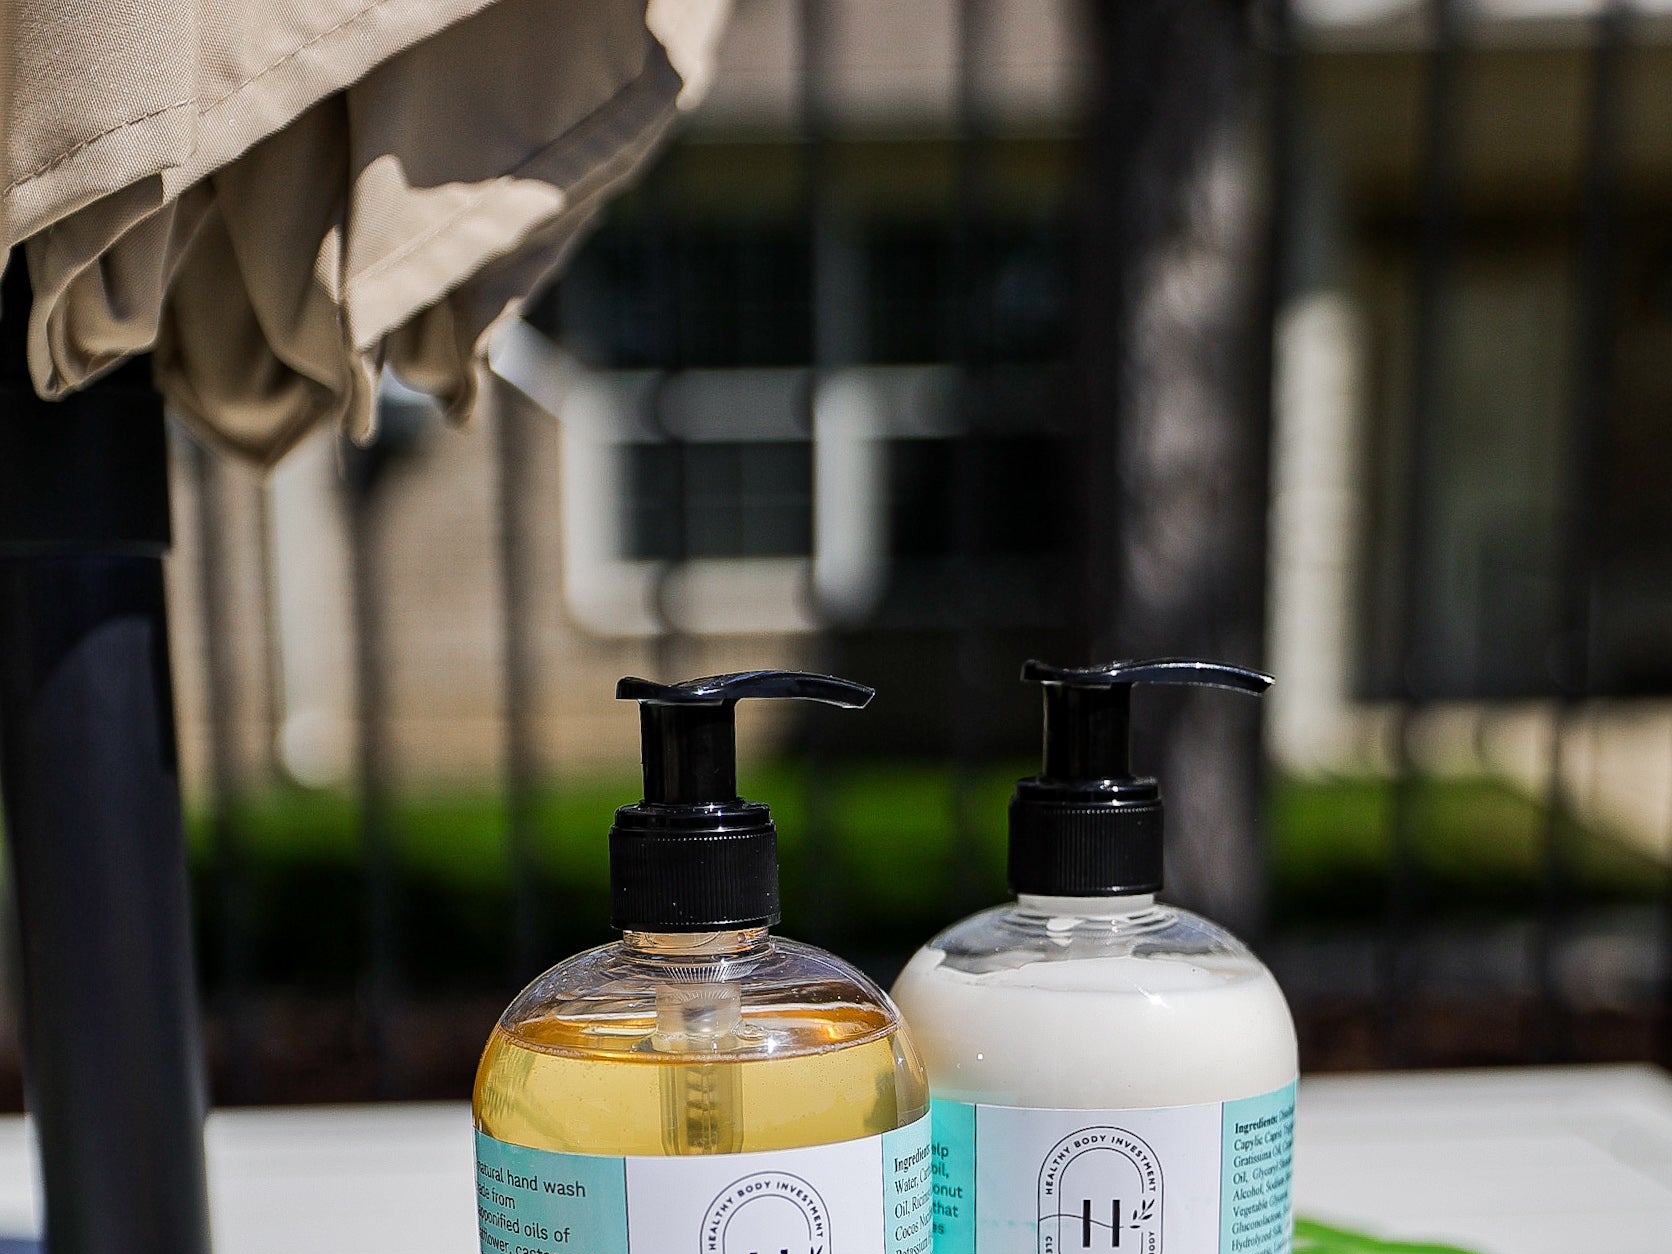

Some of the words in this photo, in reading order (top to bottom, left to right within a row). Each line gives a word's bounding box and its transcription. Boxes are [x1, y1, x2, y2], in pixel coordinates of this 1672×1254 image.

[1045, 1147, 1070, 1195] HEALTHY
[1074, 1135, 1107, 1148] BODY
[1111, 1136, 1156, 1192] INVESTMENT
[508, 1172, 538, 1191] hand
[543, 1181, 586, 1197] wash
[894, 1177, 919, 1195] Water,
[491, 1187, 516, 1209] from
[708, 1197, 734, 1251] HEALTHY
[738, 1181, 771, 1197] BODY
[777, 1181, 824, 1238] INVESTMENT
[894, 1200, 910, 1219] Oil,
[524, 1222, 548, 1240] oils
[554, 1228, 571, 1243] of
[895, 1221, 919, 1241] Cocos
